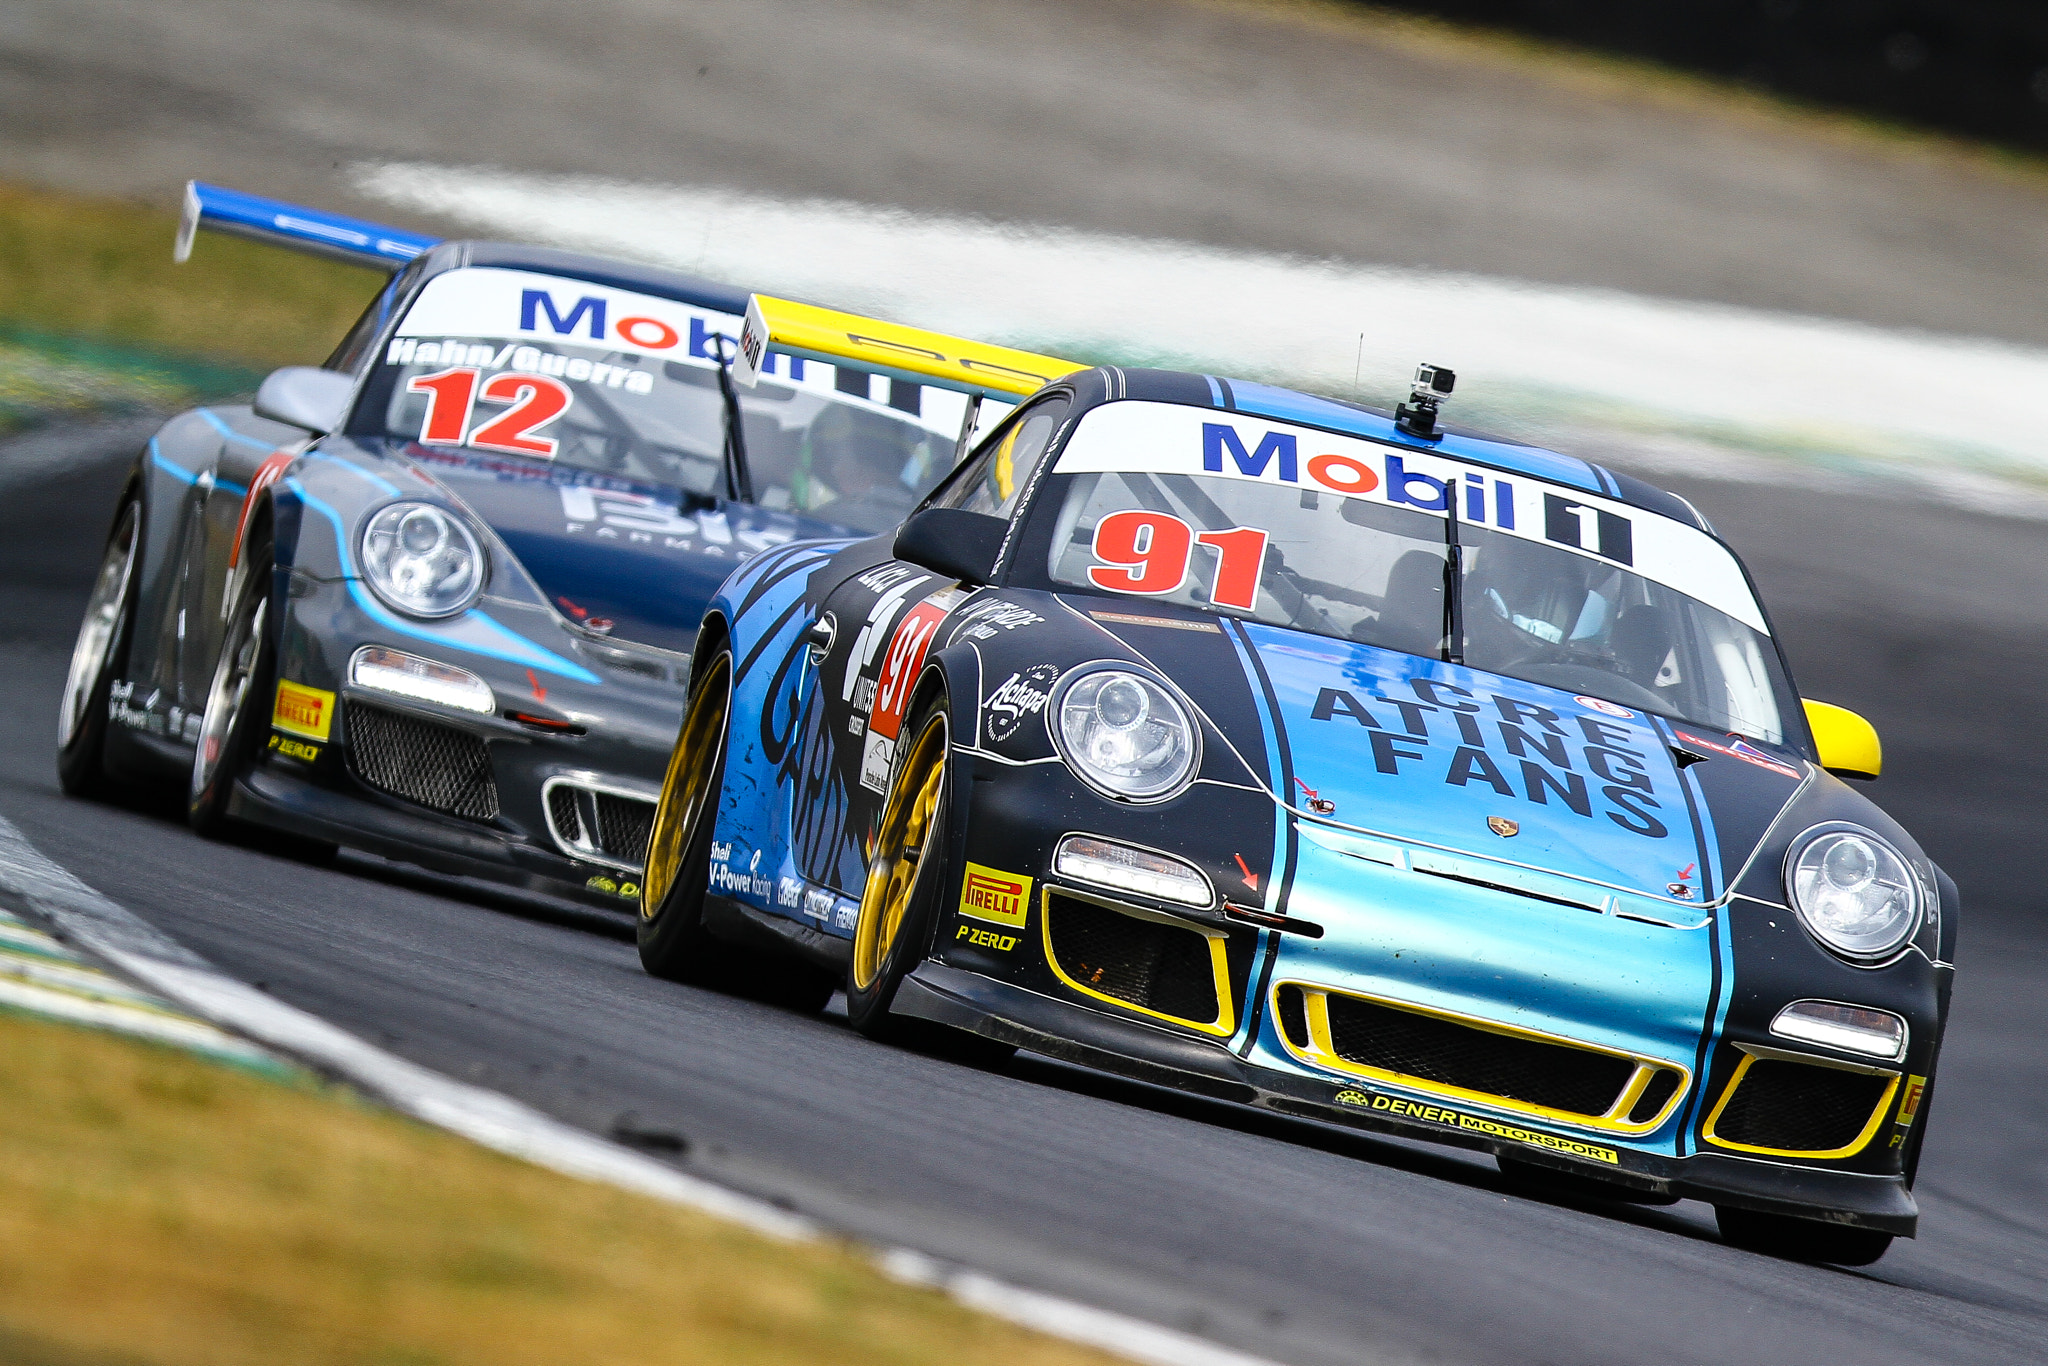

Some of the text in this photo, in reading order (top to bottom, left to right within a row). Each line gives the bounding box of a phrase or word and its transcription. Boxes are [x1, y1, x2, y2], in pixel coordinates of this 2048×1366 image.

[386, 338, 654, 395] Hahn/Guerra
[407, 367, 573, 460] 12
[1201, 422, 1515, 531] Mobil
[1087, 509, 1271, 613] 91
[881, 615, 935, 717] 91
[981, 672, 1047, 720] Achapa
[1310, 686, 1654, 795] ATING
[1367, 730, 1669, 839] FANS
[709, 861, 751, 893] V-Power
[751, 870, 771, 904] Racing
[965, 873, 1022, 915] PIRELLI
[956, 925, 1017, 951] P ZERO
[1371, 1095, 1614, 1161] DENER MOTORSPORT
